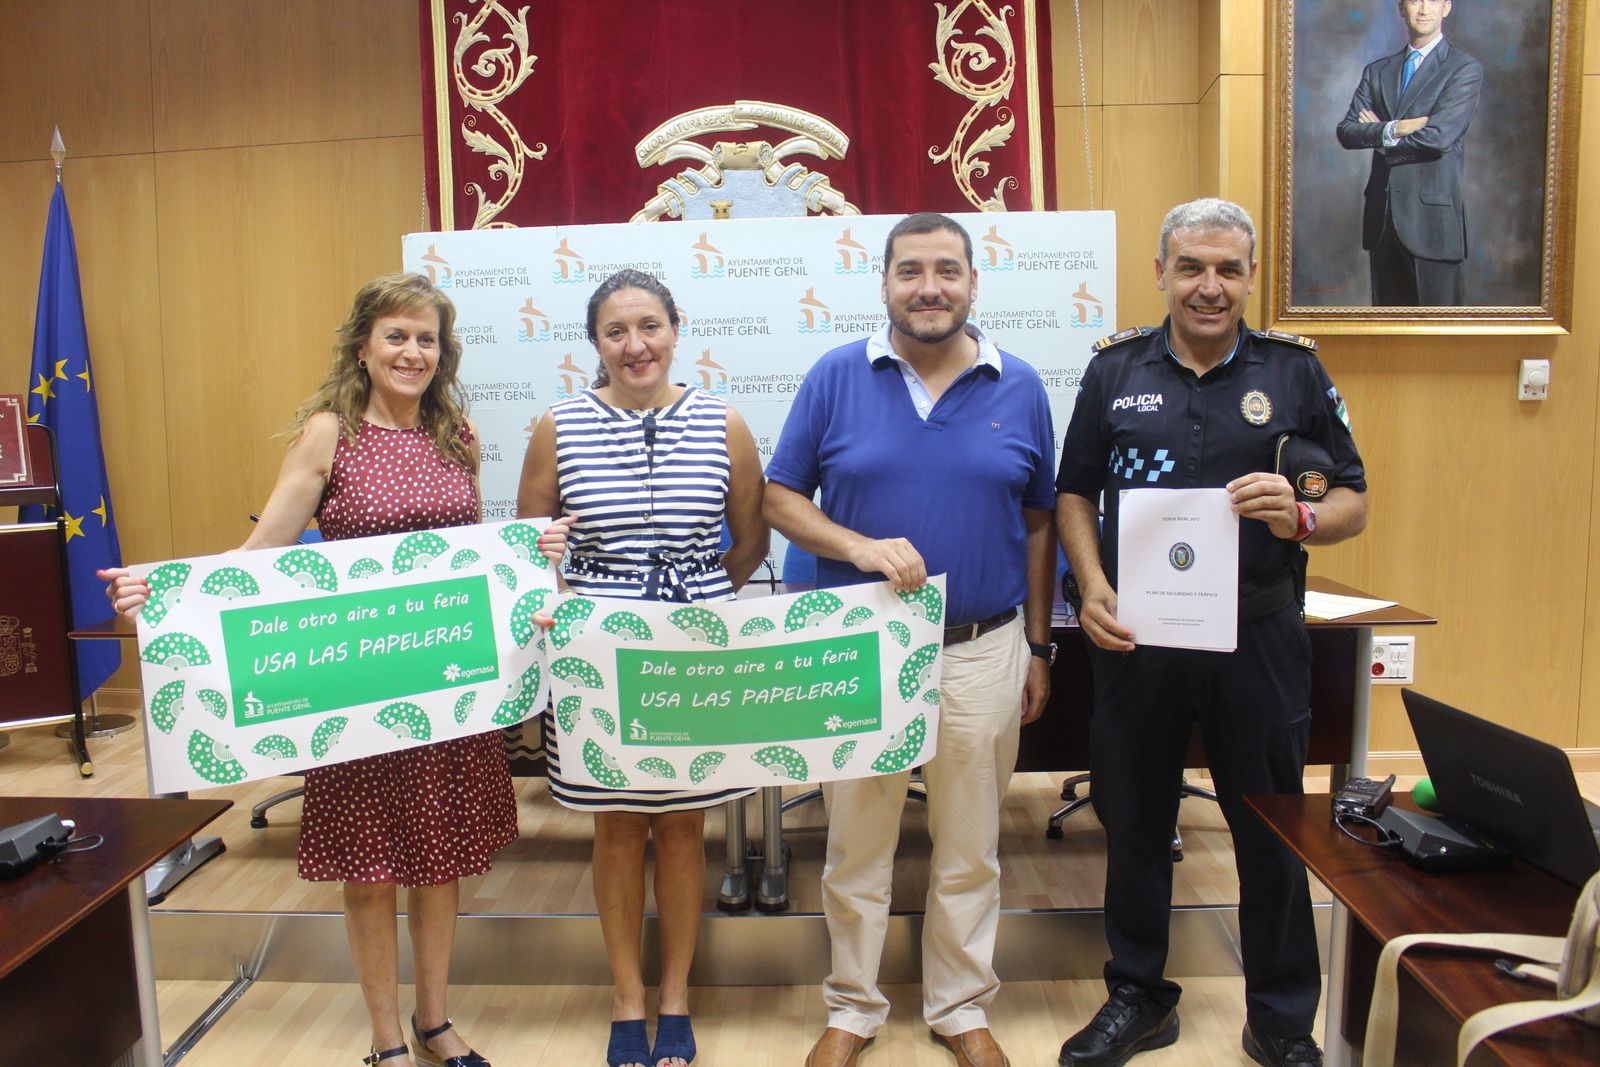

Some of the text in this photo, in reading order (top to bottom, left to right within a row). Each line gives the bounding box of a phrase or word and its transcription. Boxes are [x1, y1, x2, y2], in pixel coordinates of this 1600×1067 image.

[638, 135, 665, 158] QUOD
[666, 117, 703, 138] NATURA
[587, 262, 650, 271] AYUNTAMIENTO
[727, 258, 791, 266] AYUNTAMIENTO
[1017, 260, 1098, 271] PUENTE GENIL
[454, 267, 528, 277] AYUNTAMIENTO DE
[728, 266, 808, 278] PUENTE GENIL
[455, 276, 531, 289] PUENTE GENIL
[834, 313, 887, 322] AYUNTAMIEN
[980, 311, 1044, 319] AYUNTAMIENTO
[691, 317, 754, 326] AYUNTAMIENTO
[980, 319, 1060, 330] PUENTE GENIL
[692, 326, 772, 337] PUENTE GENIL
[835, 323, 878, 333] PUENTE
[465, 334, 498, 344] GENIL
[554, 331, 588, 341] PUENT
[730, 374, 793, 383] AYUNTAMIENTO
[731, 384, 773, 395] PUENTE
[504, 391, 537, 401] GENIL
[1112, 393, 1163, 411] POLICIA
[1137, 404, 1159, 412] LOCAL
[480, 452, 504, 462] ENIL
[249, 591, 469, 637] Dale otro aire a tu feria
[254, 621, 473, 675] USA LAS PAPELERAS
[640, 648, 858, 677] Dale otro aire a tu feria
[460, 664, 495, 678] egemasa
[640, 676, 860, 708] USA LAS PAPELERAS
[266, 703, 312, 715] PUENTE GENIL
[842, 716, 878, 729] egemasa
[1470, 773, 1524, 807] TOSHIBA
